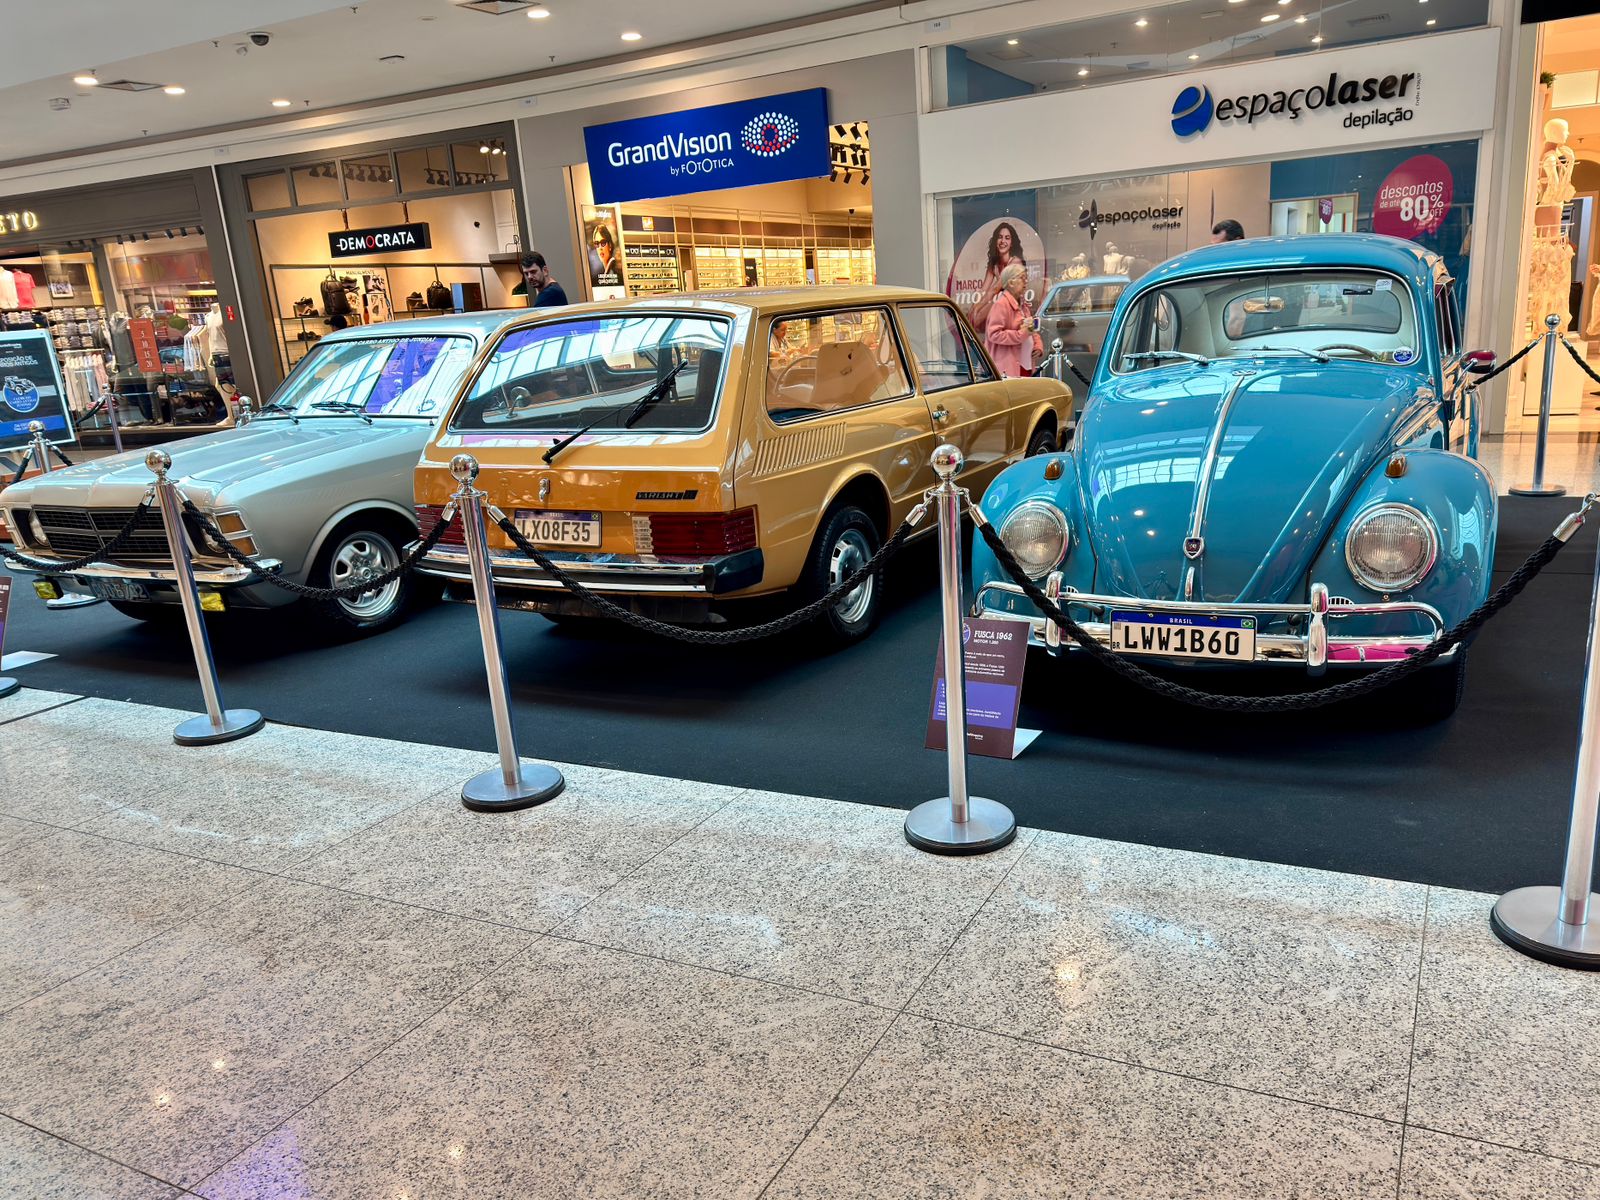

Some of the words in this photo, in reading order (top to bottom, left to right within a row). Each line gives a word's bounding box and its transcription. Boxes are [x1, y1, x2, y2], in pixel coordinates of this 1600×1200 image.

[1215, 72, 1415, 124] espaçolaser
[1343, 107, 1413, 129] depilação
[607, 132, 732, 167] GrandVision
[670, 166, 679, 176] by
[1381, 181, 1443, 200] descontos
[1097, 206, 1183, 226] espaçolaser
[1389, 199, 1400, 208] até
[1400, 194, 1444, 222] 80%
[1152, 221, 1181, 231] depilação
[337, 231, 415, 251] DEMOCRATA
[956, 279, 983, 292] MARÇO
[1169, 617, 1193, 625] BRASIL
[974, 630, 995, 640] FUSCA
[996, 632, 1013, 640] 1962
[1124, 625, 1240, 655] LWW1B60
[1112, 641, 1121, 649] BR
